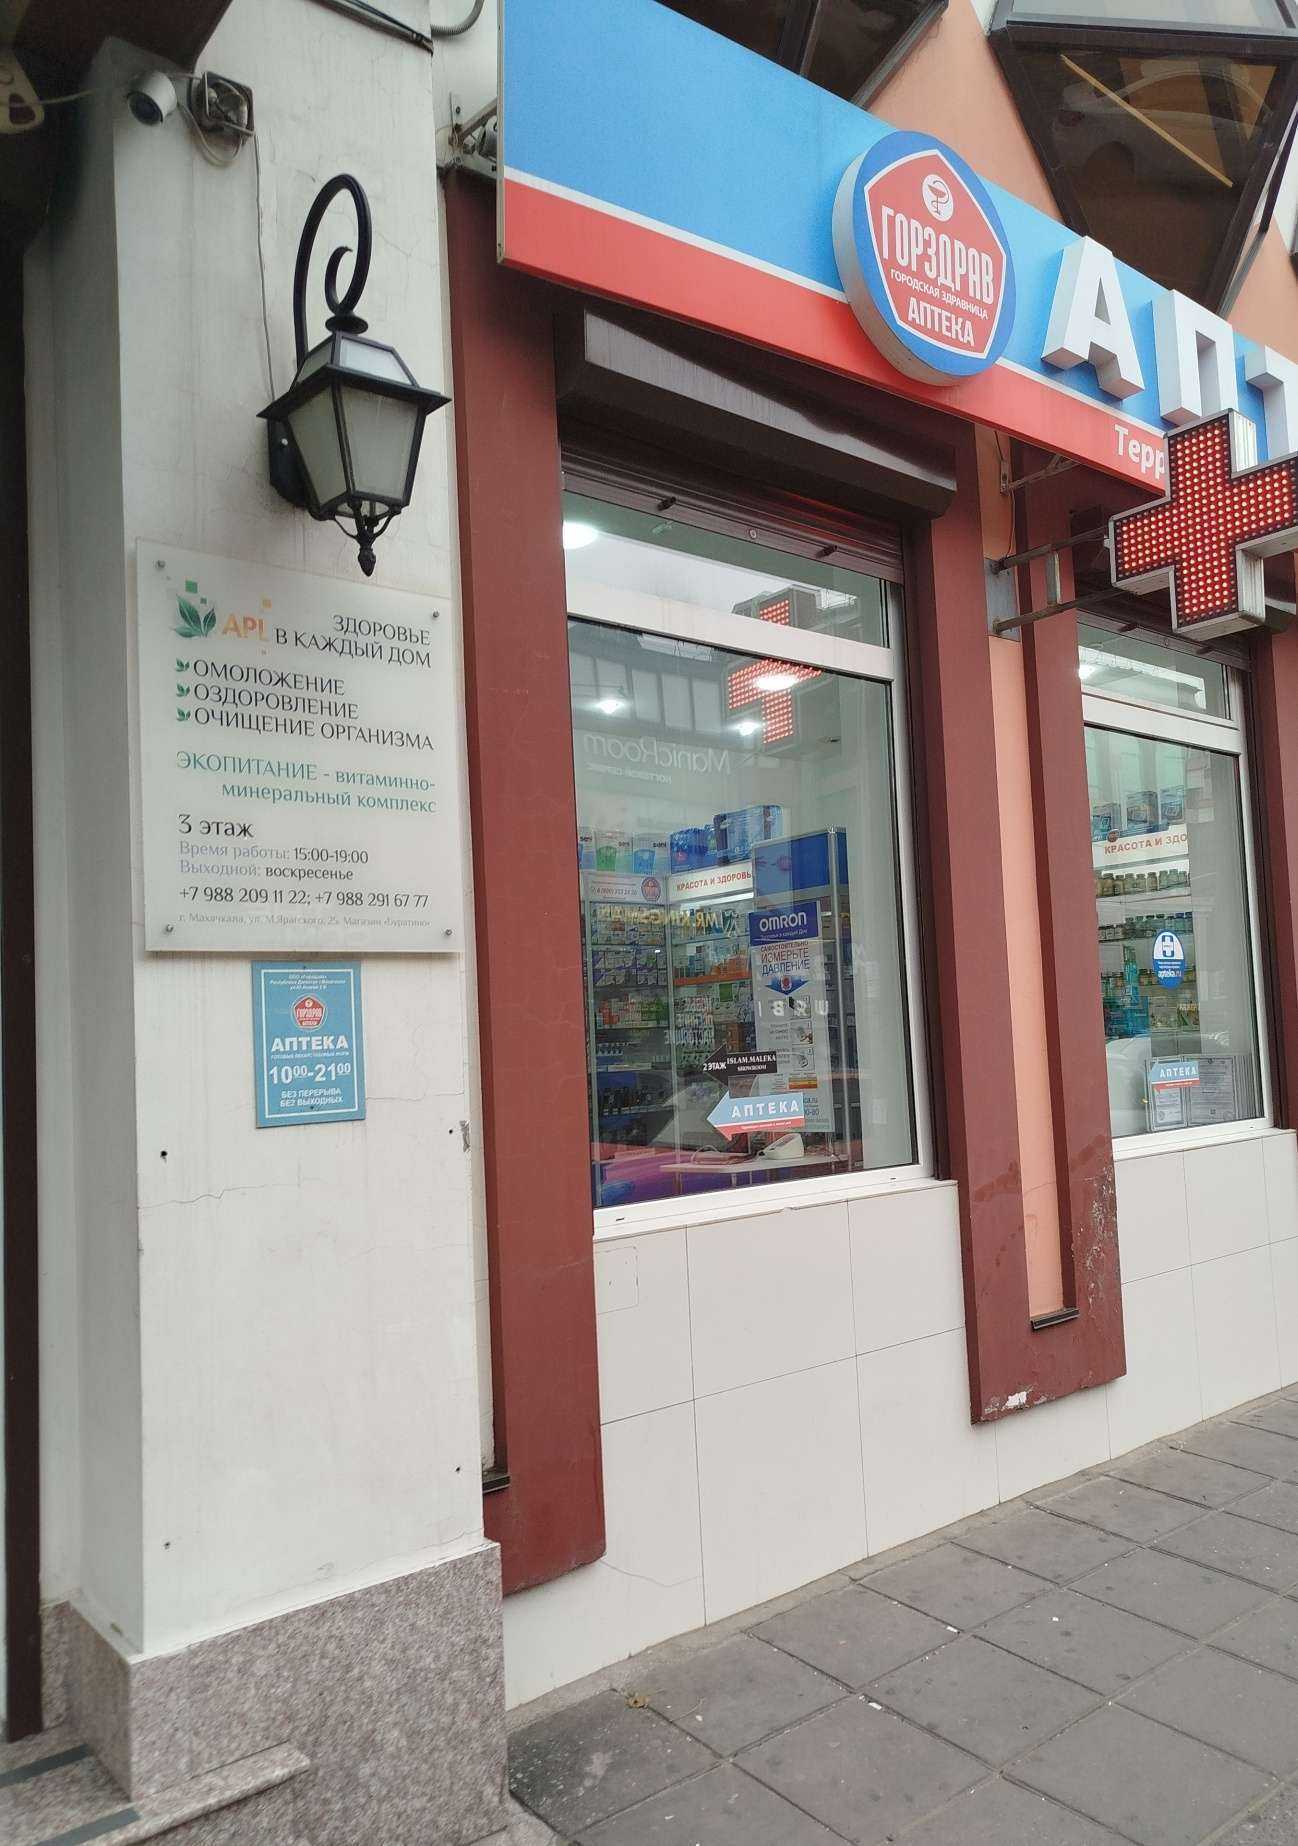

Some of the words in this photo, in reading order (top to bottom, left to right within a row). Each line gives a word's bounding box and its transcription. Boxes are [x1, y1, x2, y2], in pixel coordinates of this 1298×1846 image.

[882, 205, 993, 304] ГОРЗДРАВ
[890, 268, 940, 299] ГОРОДСКАЯ
[941, 290, 988, 320] ЗДРАВНИЦА
[908, 297, 975, 347] АПТЕКА
[333, 615, 431, 646] ЗДОРОВЬЕ
[276, 628, 288, 645] В
[295, 632, 384, 661] КАЖДЫЙ
[388, 646, 432, 668] ДОМ
[193, 659, 345, 695] ОМОЛОЖЕНИЕ
[194, 683, 359, 719] ОЗДОРОВЛЕНИЕ
[194, 708, 315, 737] ОЧИЩЕНИЕ
[321, 724, 434, 751] ОРГАНИЗМА
[176, 751, 317, 781] ЭКОПИТАНИЕ
[335, 771, 435, 791] витаминно-
[222, 783, 352, 807] минеральный
[357, 793, 437, 813] комплекс
[178, 813, 192, 835] 3
[199, 819, 254, 839] этаж
[179, 841, 229, 859] Время
[233, 843, 290, 861] работы:
[293, 847, 369, 865] 15:00-19:00
[1105, 839, 1153, 855] КРАСОТА
[1154, 837, 1163, 846] И
[1165, 833, 1187, 845] ЗДО
[179, 859, 261, 877] Выходной:
[264, 865, 354, 881] воскресенье
[179, 886, 199, 902] +7
[203, 887, 234, 902] 988
[238, 888, 269, 903] 209
[272, 889, 283, 903] 11
[314, 890, 332, 905] +7
[336, 891, 363, 906] 988
[367, 892, 390, 907] 291
[394, 893, 410, 908] 67
[412, 893, 429, 908] 77
[676, 879, 708, 892] КРАСОТА
[271, 1035, 349, 1053] АПТЕКА
[702, 1063, 708, 1072] 2
[708, 1061, 727, 1072] ЭТАЖ
[1160, 1066, 1197, 1079] АПТЕКА
[280, 1099, 296, 1108] БЕЗ
[297, 1095, 343, 1106] ВЫХОДНЫХ
[281, 1090, 297, 1099] БЕЗ
[298, 1087, 342, 1098] ПЕРЕРЫВА
[731, 1098, 800, 1118] АПТЕКА
